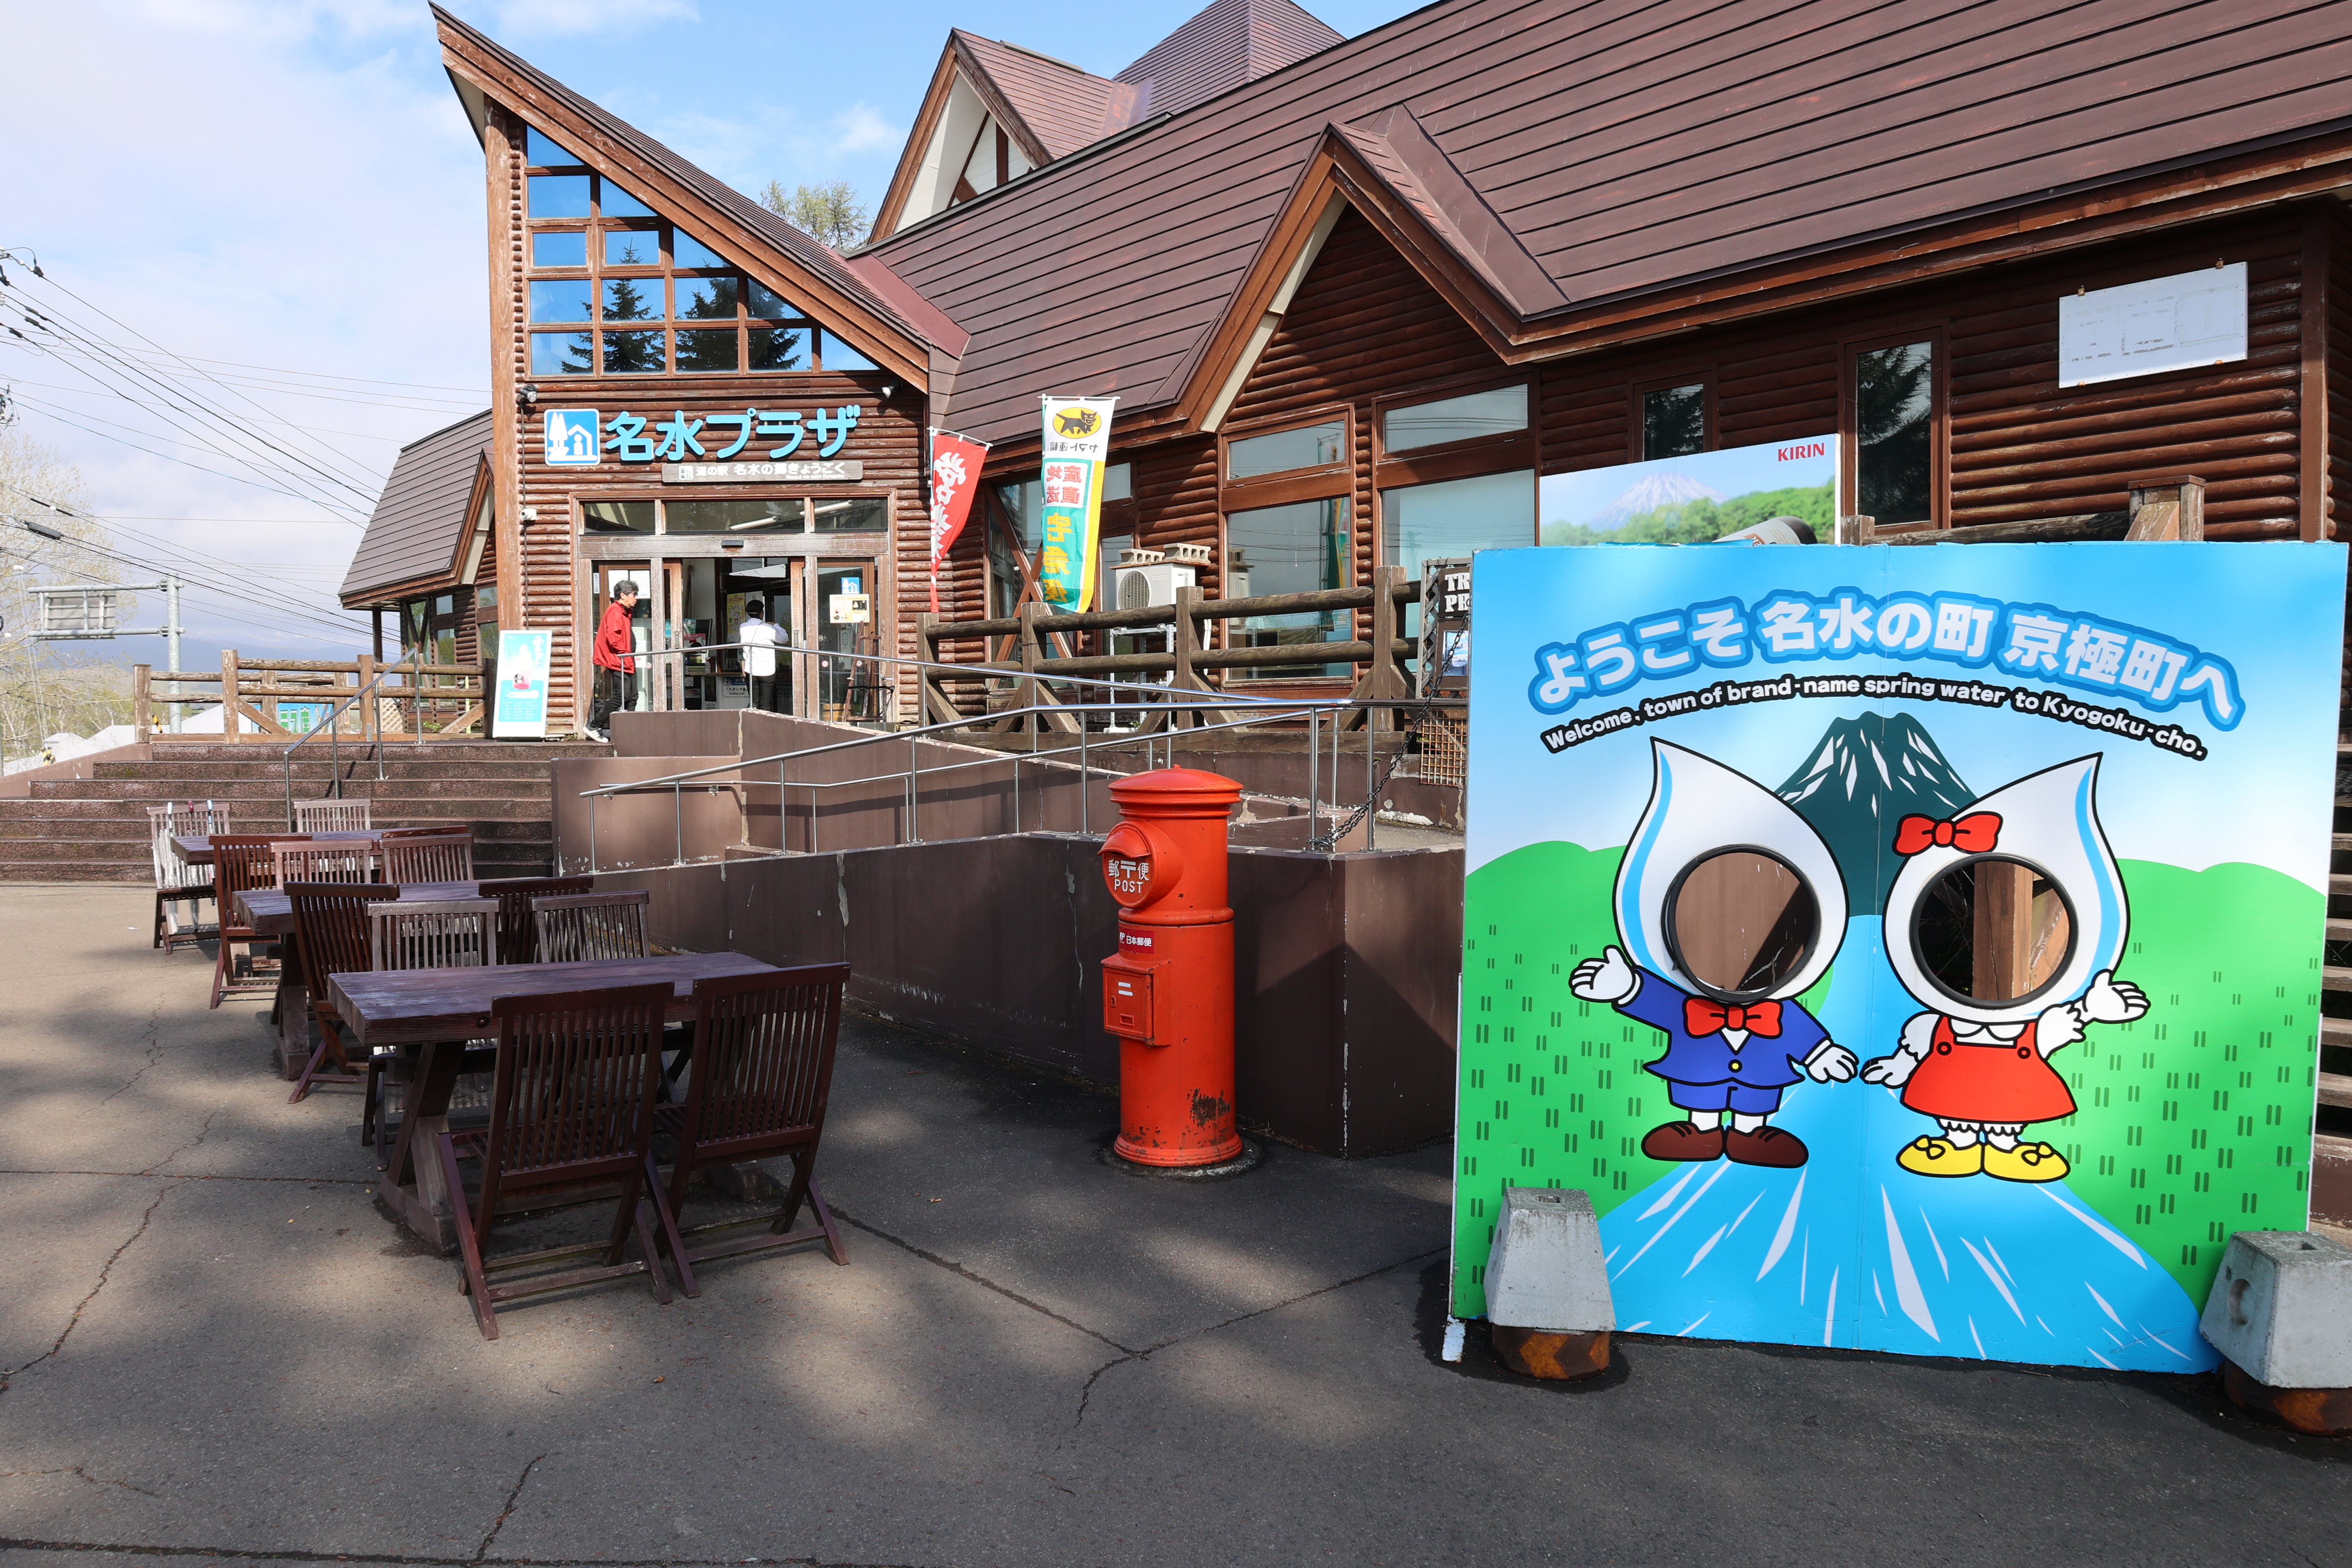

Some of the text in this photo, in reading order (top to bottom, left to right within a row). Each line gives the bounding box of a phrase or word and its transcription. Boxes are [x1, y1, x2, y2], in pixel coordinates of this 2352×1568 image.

[605, 404, 861, 461] 名水プラザ
[1778, 442, 1825, 462] KIRIN
[696, 466, 728, 477] 道の駅
[1538, 597, 2234, 720] ようこそ 名水の町 京極町へ
[1644, 695, 1697, 717] town
[1700, 686, 1723, 705] of
[1864, 677, 1936, 696] spring
[1940, 683, 2006, 703] water
[2015, 691, 2039, 710] to
[1114, 879, 1143, 894] POST
[1126, 935, 1152, 947] 日本郵便
